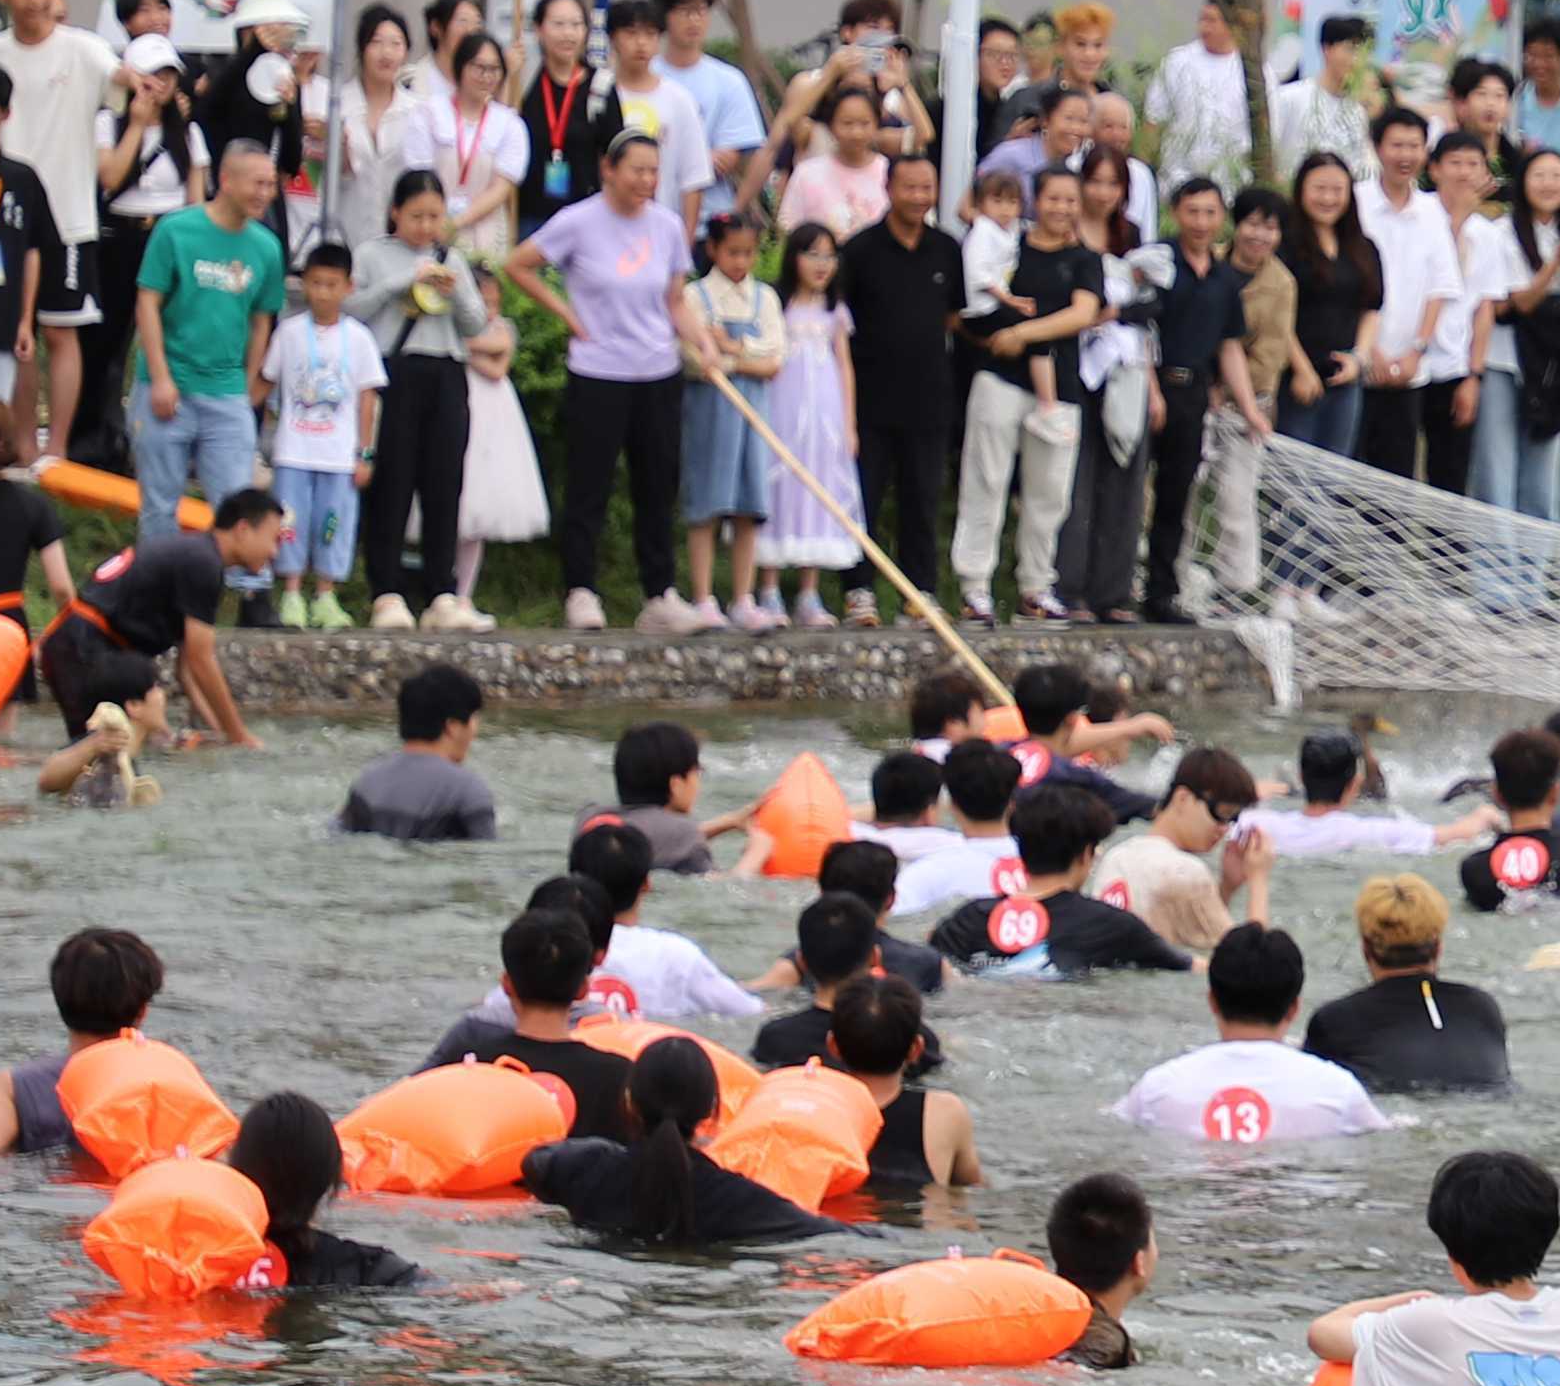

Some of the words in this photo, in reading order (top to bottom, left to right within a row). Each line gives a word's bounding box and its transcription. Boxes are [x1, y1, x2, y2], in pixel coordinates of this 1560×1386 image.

[1502, 845, 1539, 882] 40
[998, 909, 1038, 947] 69
[1212, 1100, 1262, 1144] 13
